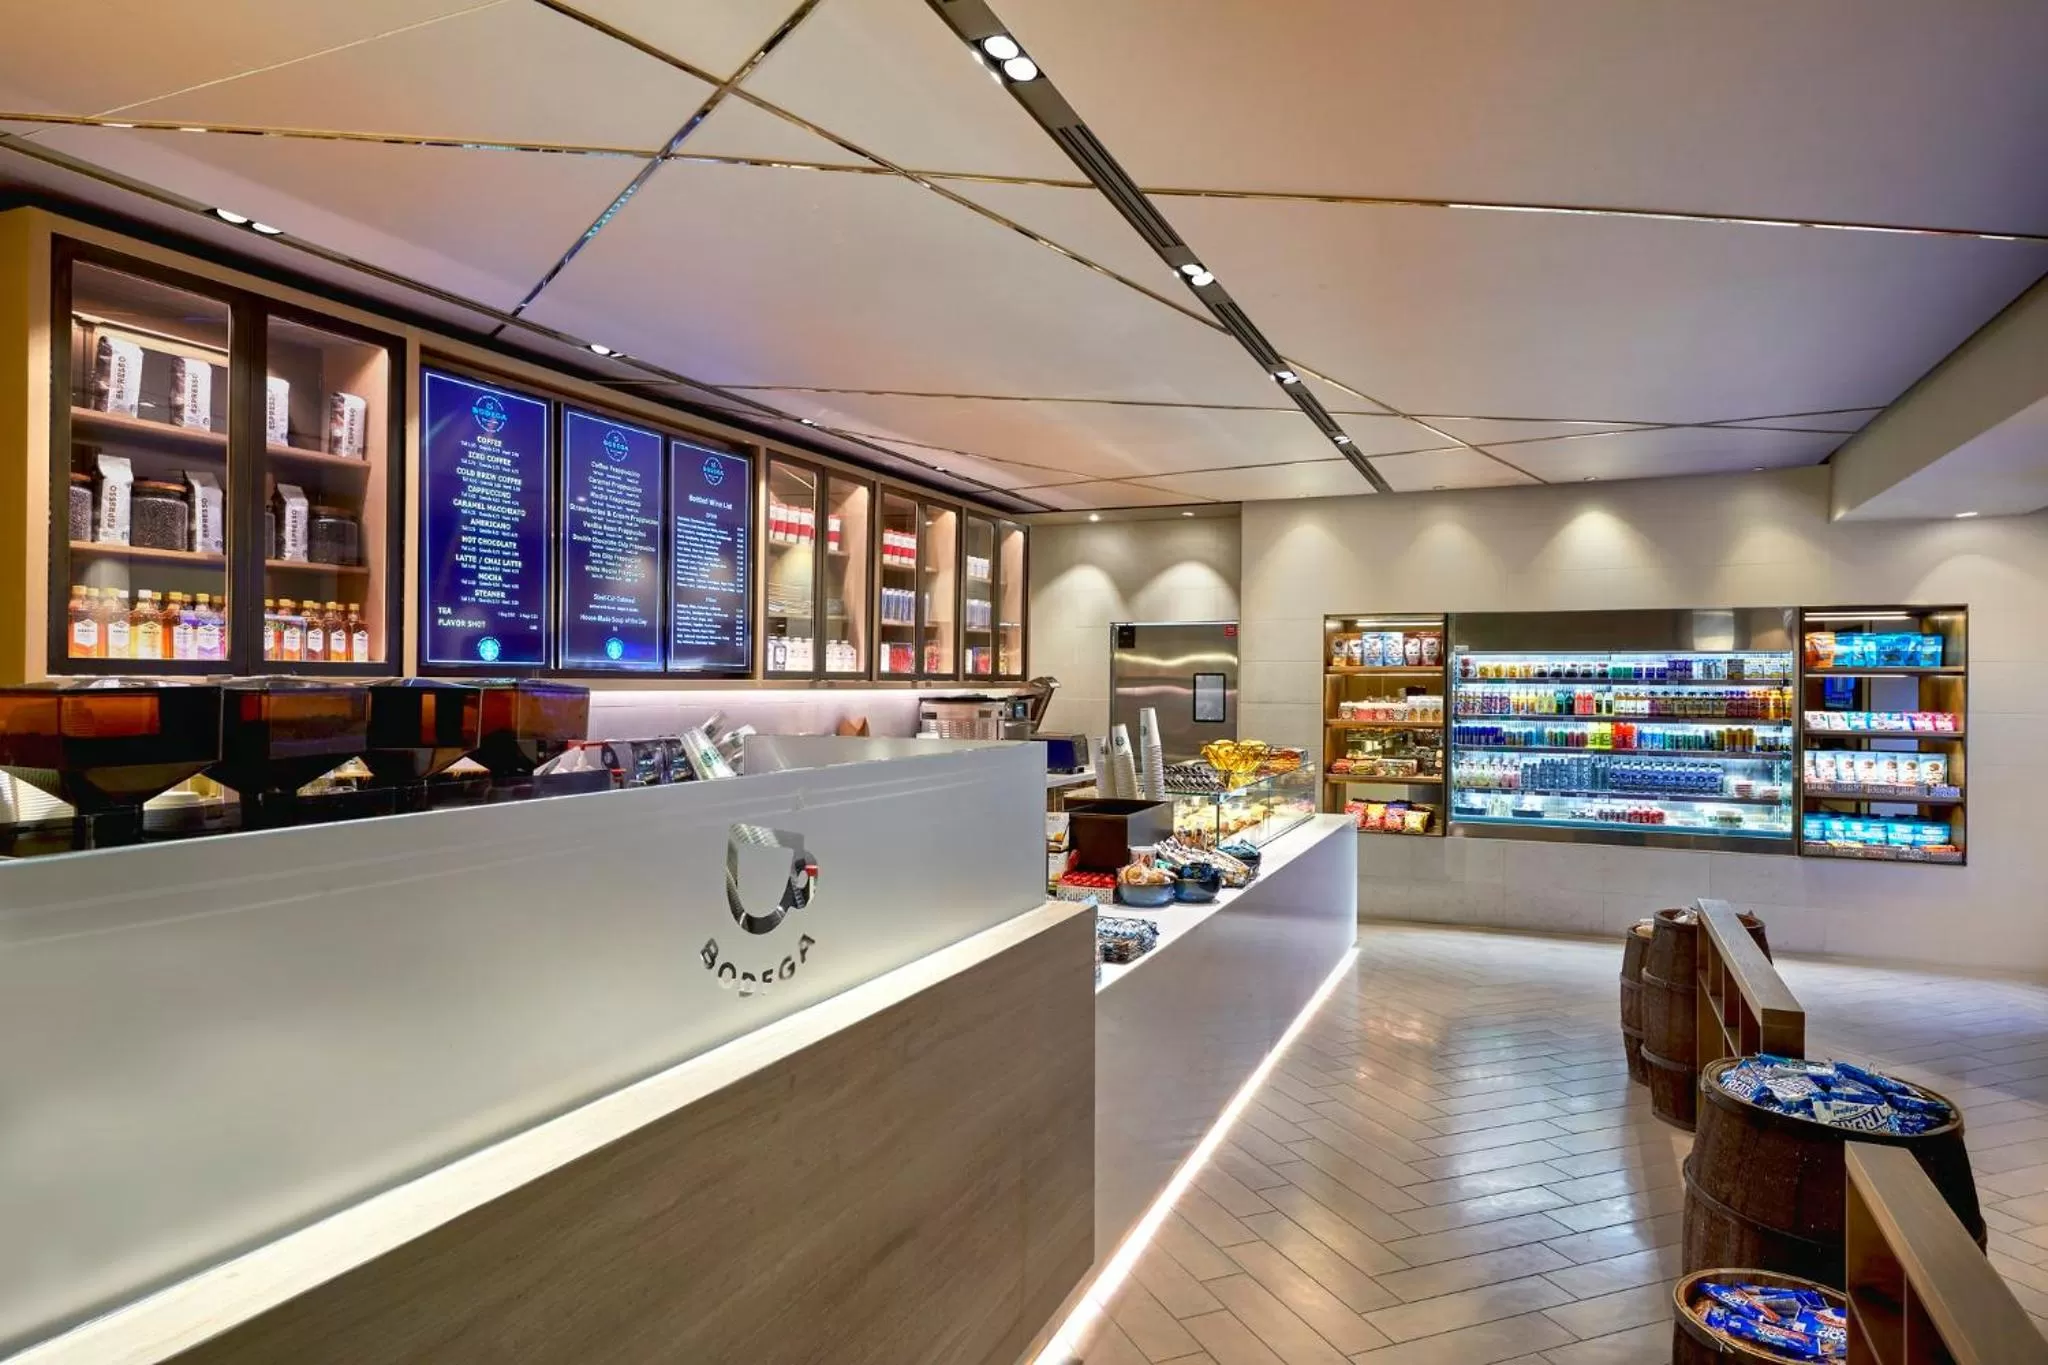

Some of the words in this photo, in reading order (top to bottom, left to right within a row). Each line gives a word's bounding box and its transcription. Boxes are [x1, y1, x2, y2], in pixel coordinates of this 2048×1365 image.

[477, 436, 502, 447] COFFEE
[468, 451, 485, 460] ICED
[487, 455, 512, 466] COFFEE
[456, 467, 476, 476] COLD
[476, 470, 496, 480] BREW
[498, 476, 522, 486] COFFEE
[468, 485, 512, 498] CAPPUCCINO
[107, 485, 118, 529] ESPRESSO
[453, 498, 485, 510] CARAMEL
[487, 504, 526, 516] MACCHIATO
[201, 497, 209, 538] ESPRESSO
[612, 511, 630, 520] Cream
[470, 518, 511, 530] AMERICANO
[462, 536, 476, 544] HOT
[478, 538, 517, 548] CHOCOLATE
[456, 554, 476, 562] LATTE
[484, 557, 501, 566] CHAI
[502, 559, 522, 568] LATTE
[478, 573, 502, 582] MOCHA
[475, 590, 506, 598] STEAMER
[438, 619, 465, 627] FLAVOR
[467, 620, 486, 628] SHOT
[1721, 1079, 1753, 1098] TREATS
